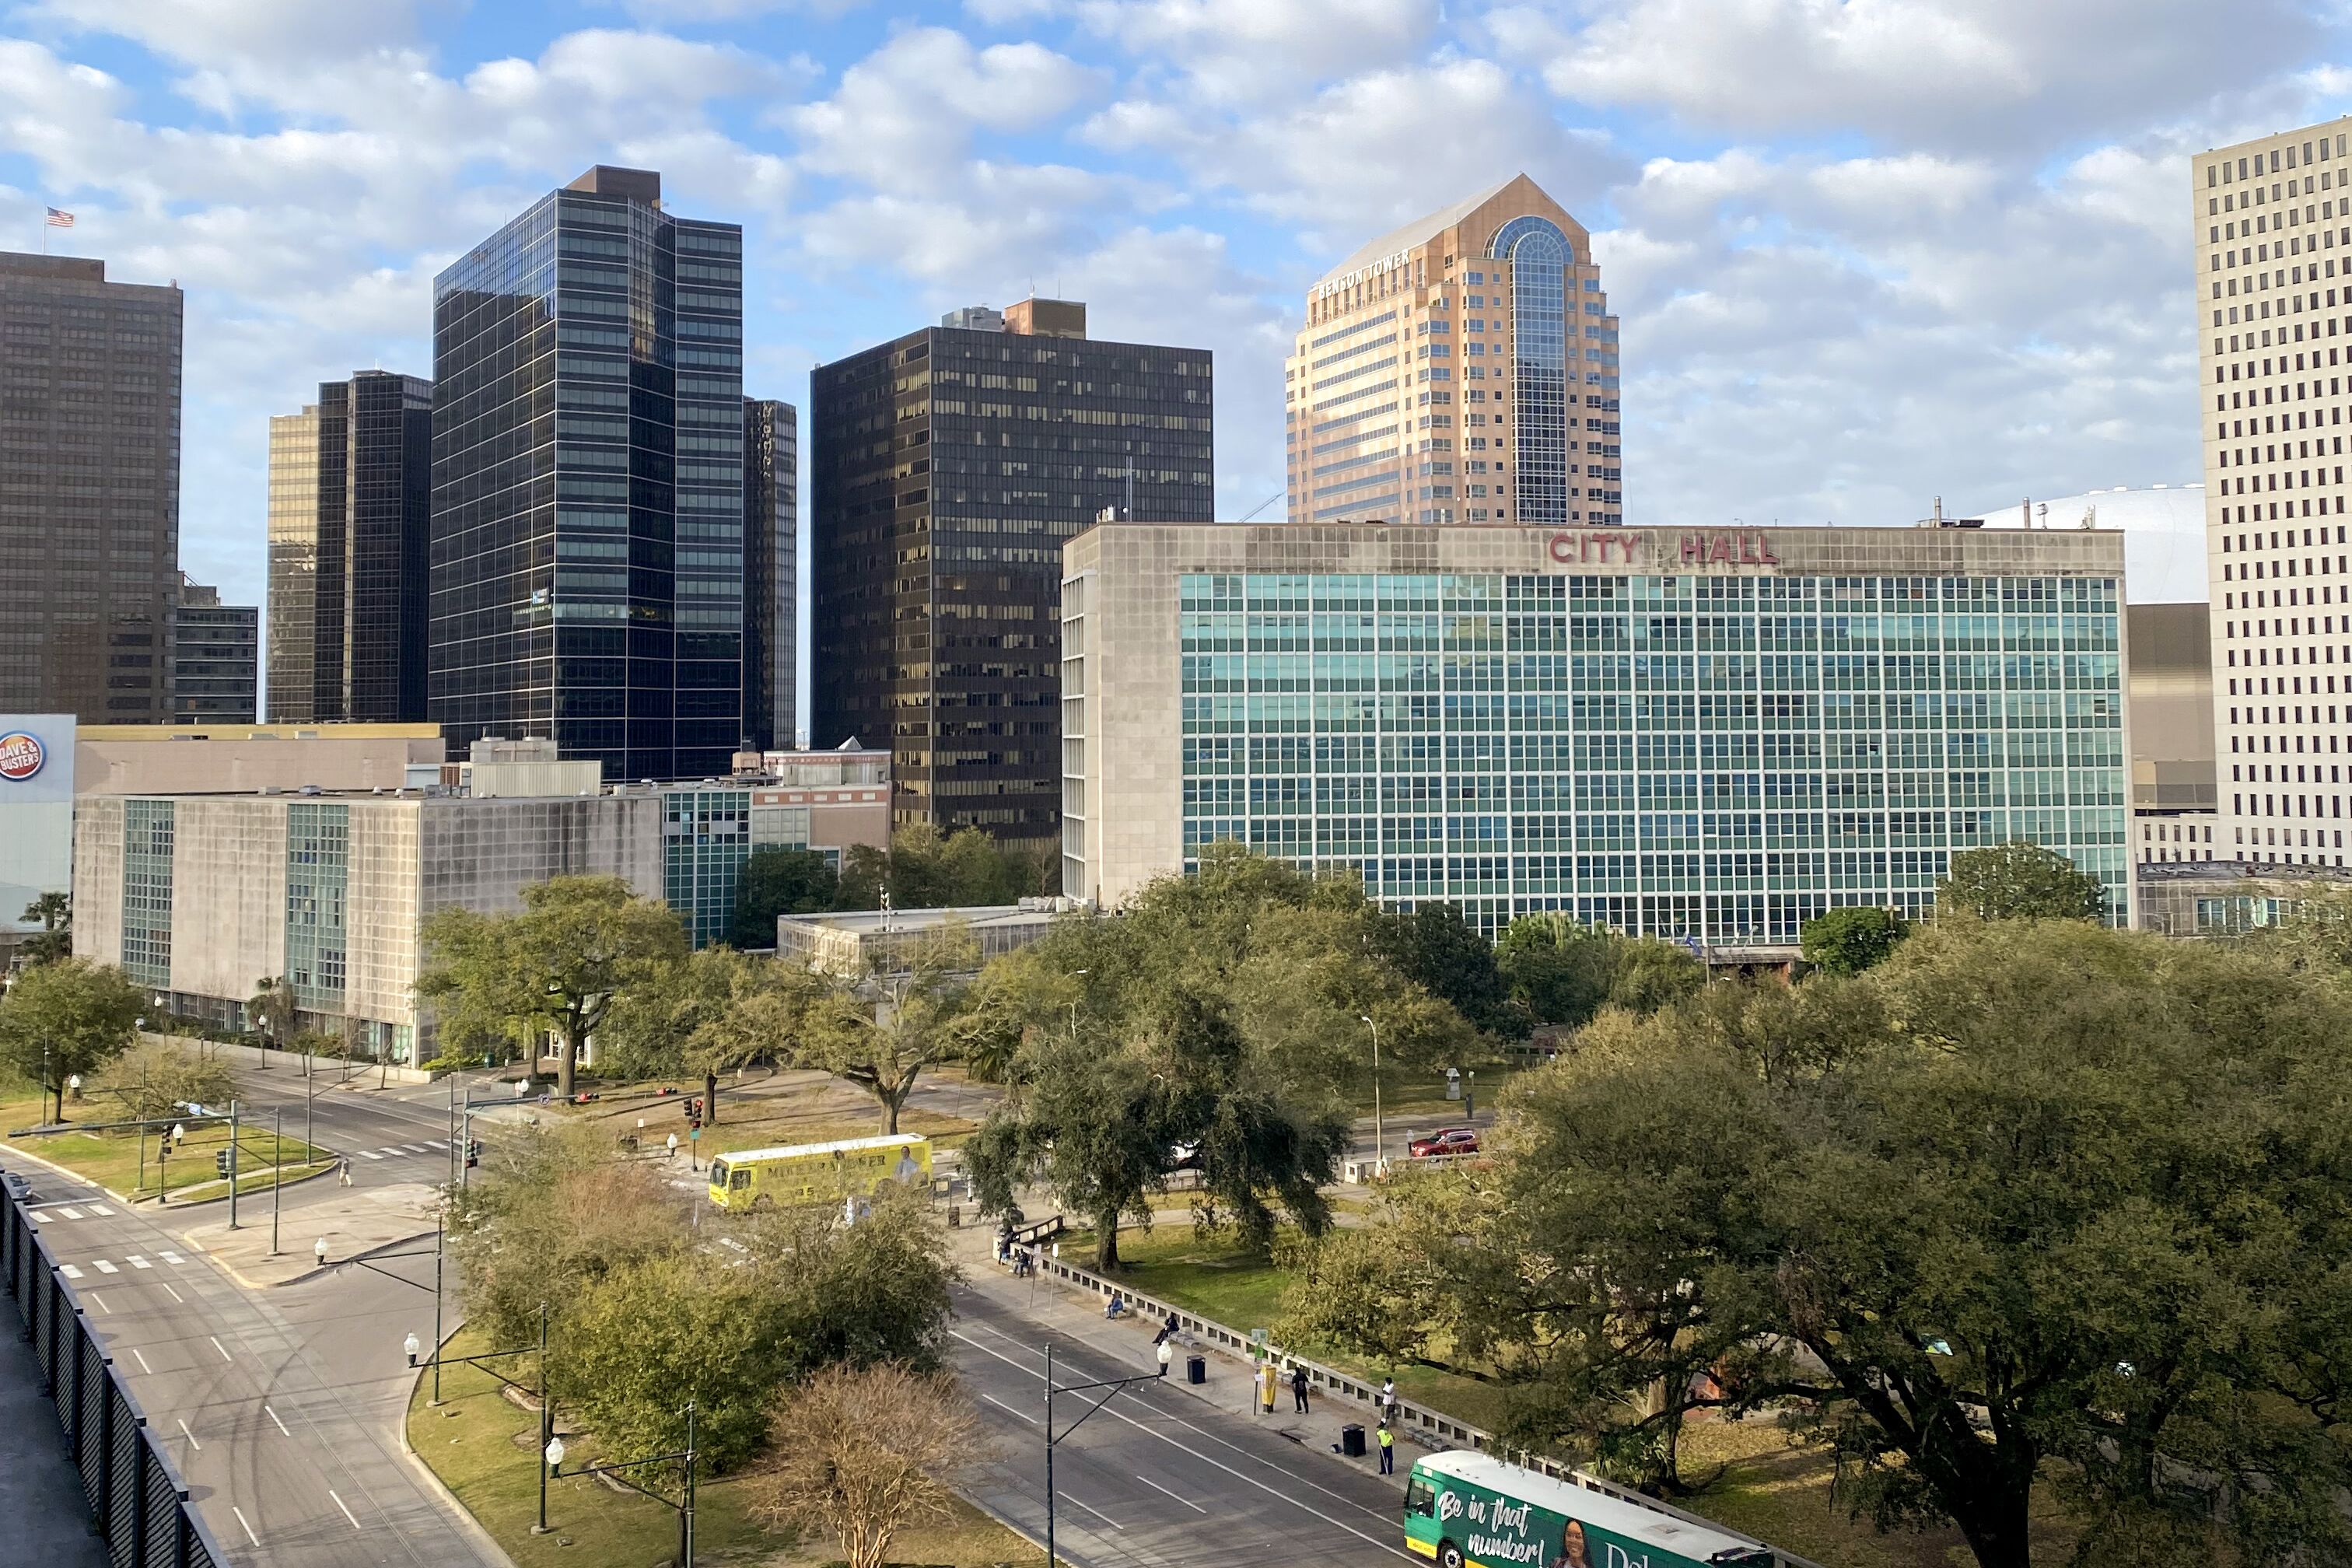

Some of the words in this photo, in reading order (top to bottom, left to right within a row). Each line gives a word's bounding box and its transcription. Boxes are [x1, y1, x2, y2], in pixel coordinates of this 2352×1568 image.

[1318, 270, 1362, 300] BENSON
[1368, 249, 1410, 279] TOWER
[1549, 532, 1640, 563] CITY
[1679, 534, 1779, 564] HALL
[0, 741, 29, 760] DAVE
[27, 740, 37, 753] &
[1437, 1490, 1463, 1521] Be
[1468, 1494, 1486, 1524] in
[1490, 1497, 1532, 1538] that
[1468, 1531, 1545, 1568] number!
